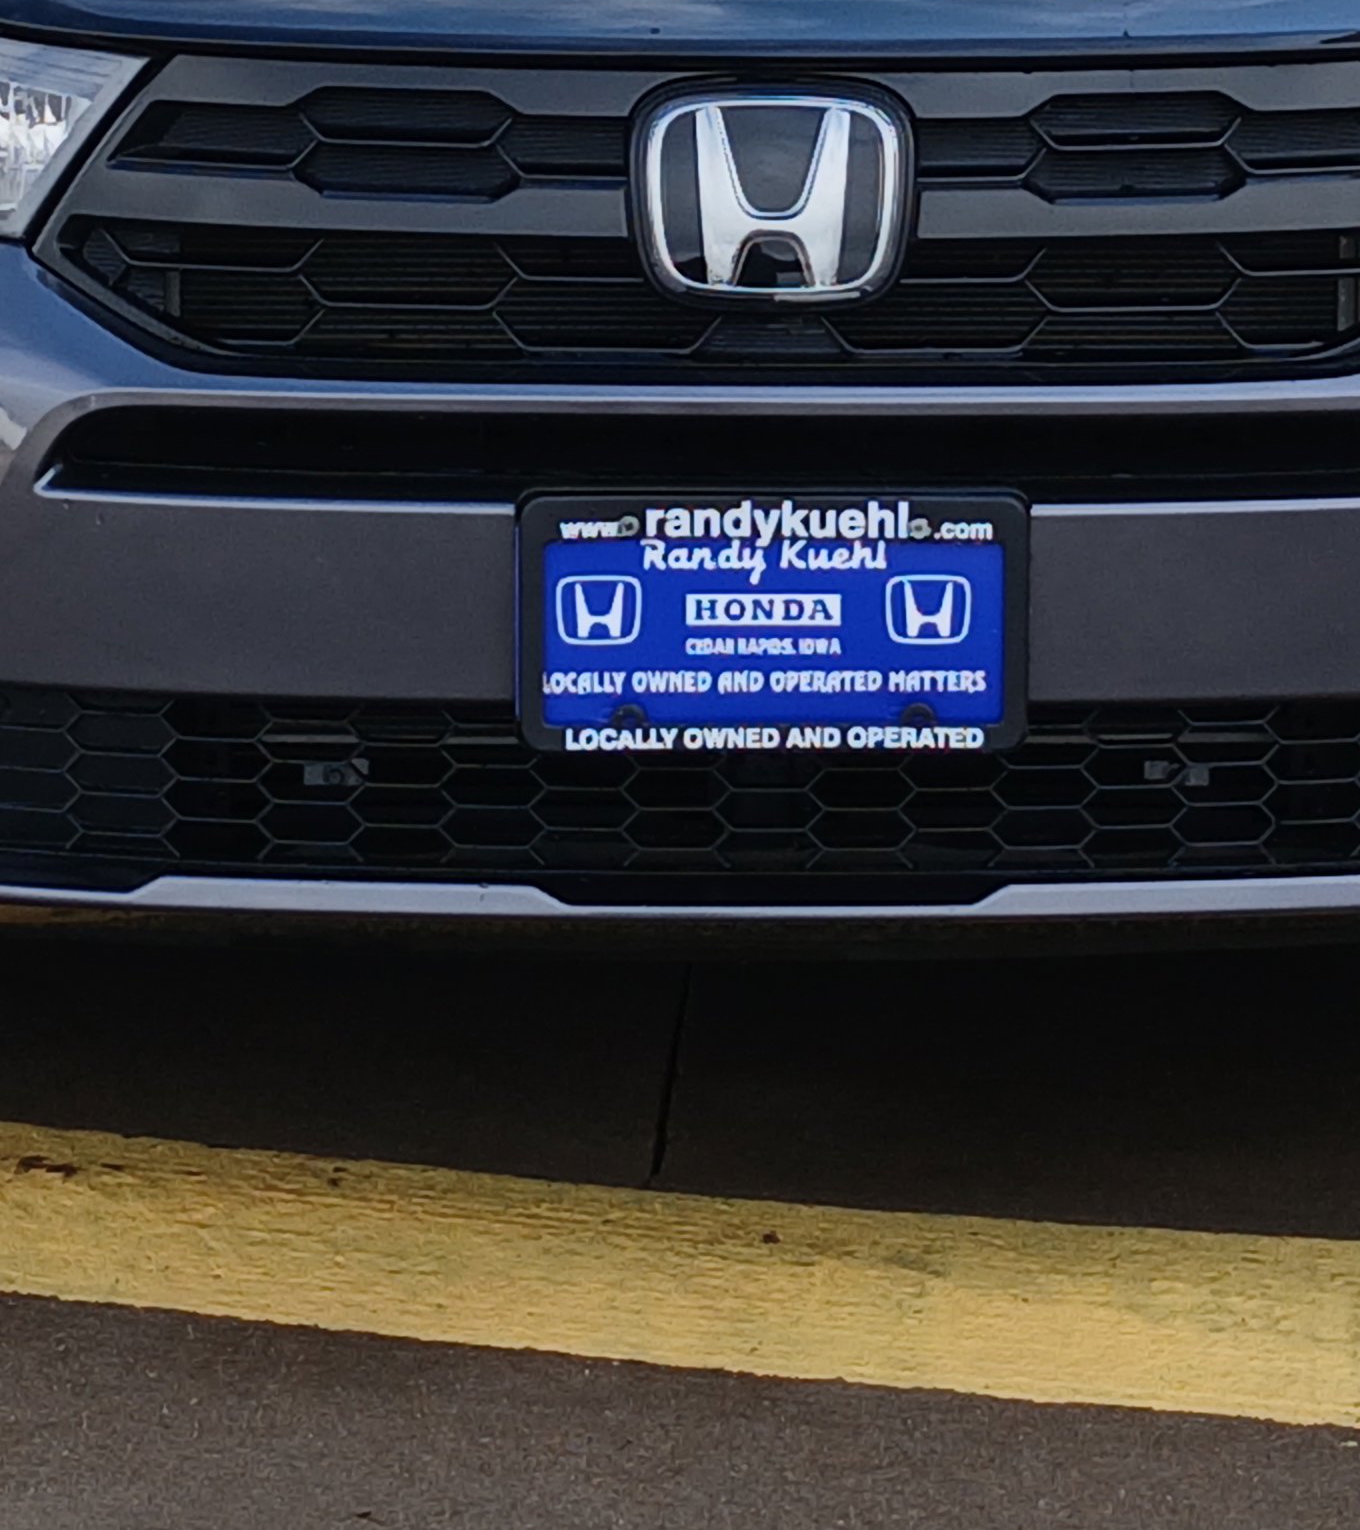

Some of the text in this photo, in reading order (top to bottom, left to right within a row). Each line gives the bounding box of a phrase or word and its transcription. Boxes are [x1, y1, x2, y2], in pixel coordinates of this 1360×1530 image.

[640, 539, 887, 585] Randy Kuehl
[693, 599, 834, 621] HONDA
[542, 670, 987, 695] LOCALLY OWNED AND OPERATED MATTERS
[565, 725, 984, 751] LOCALLY OWNED AND OPERATED
